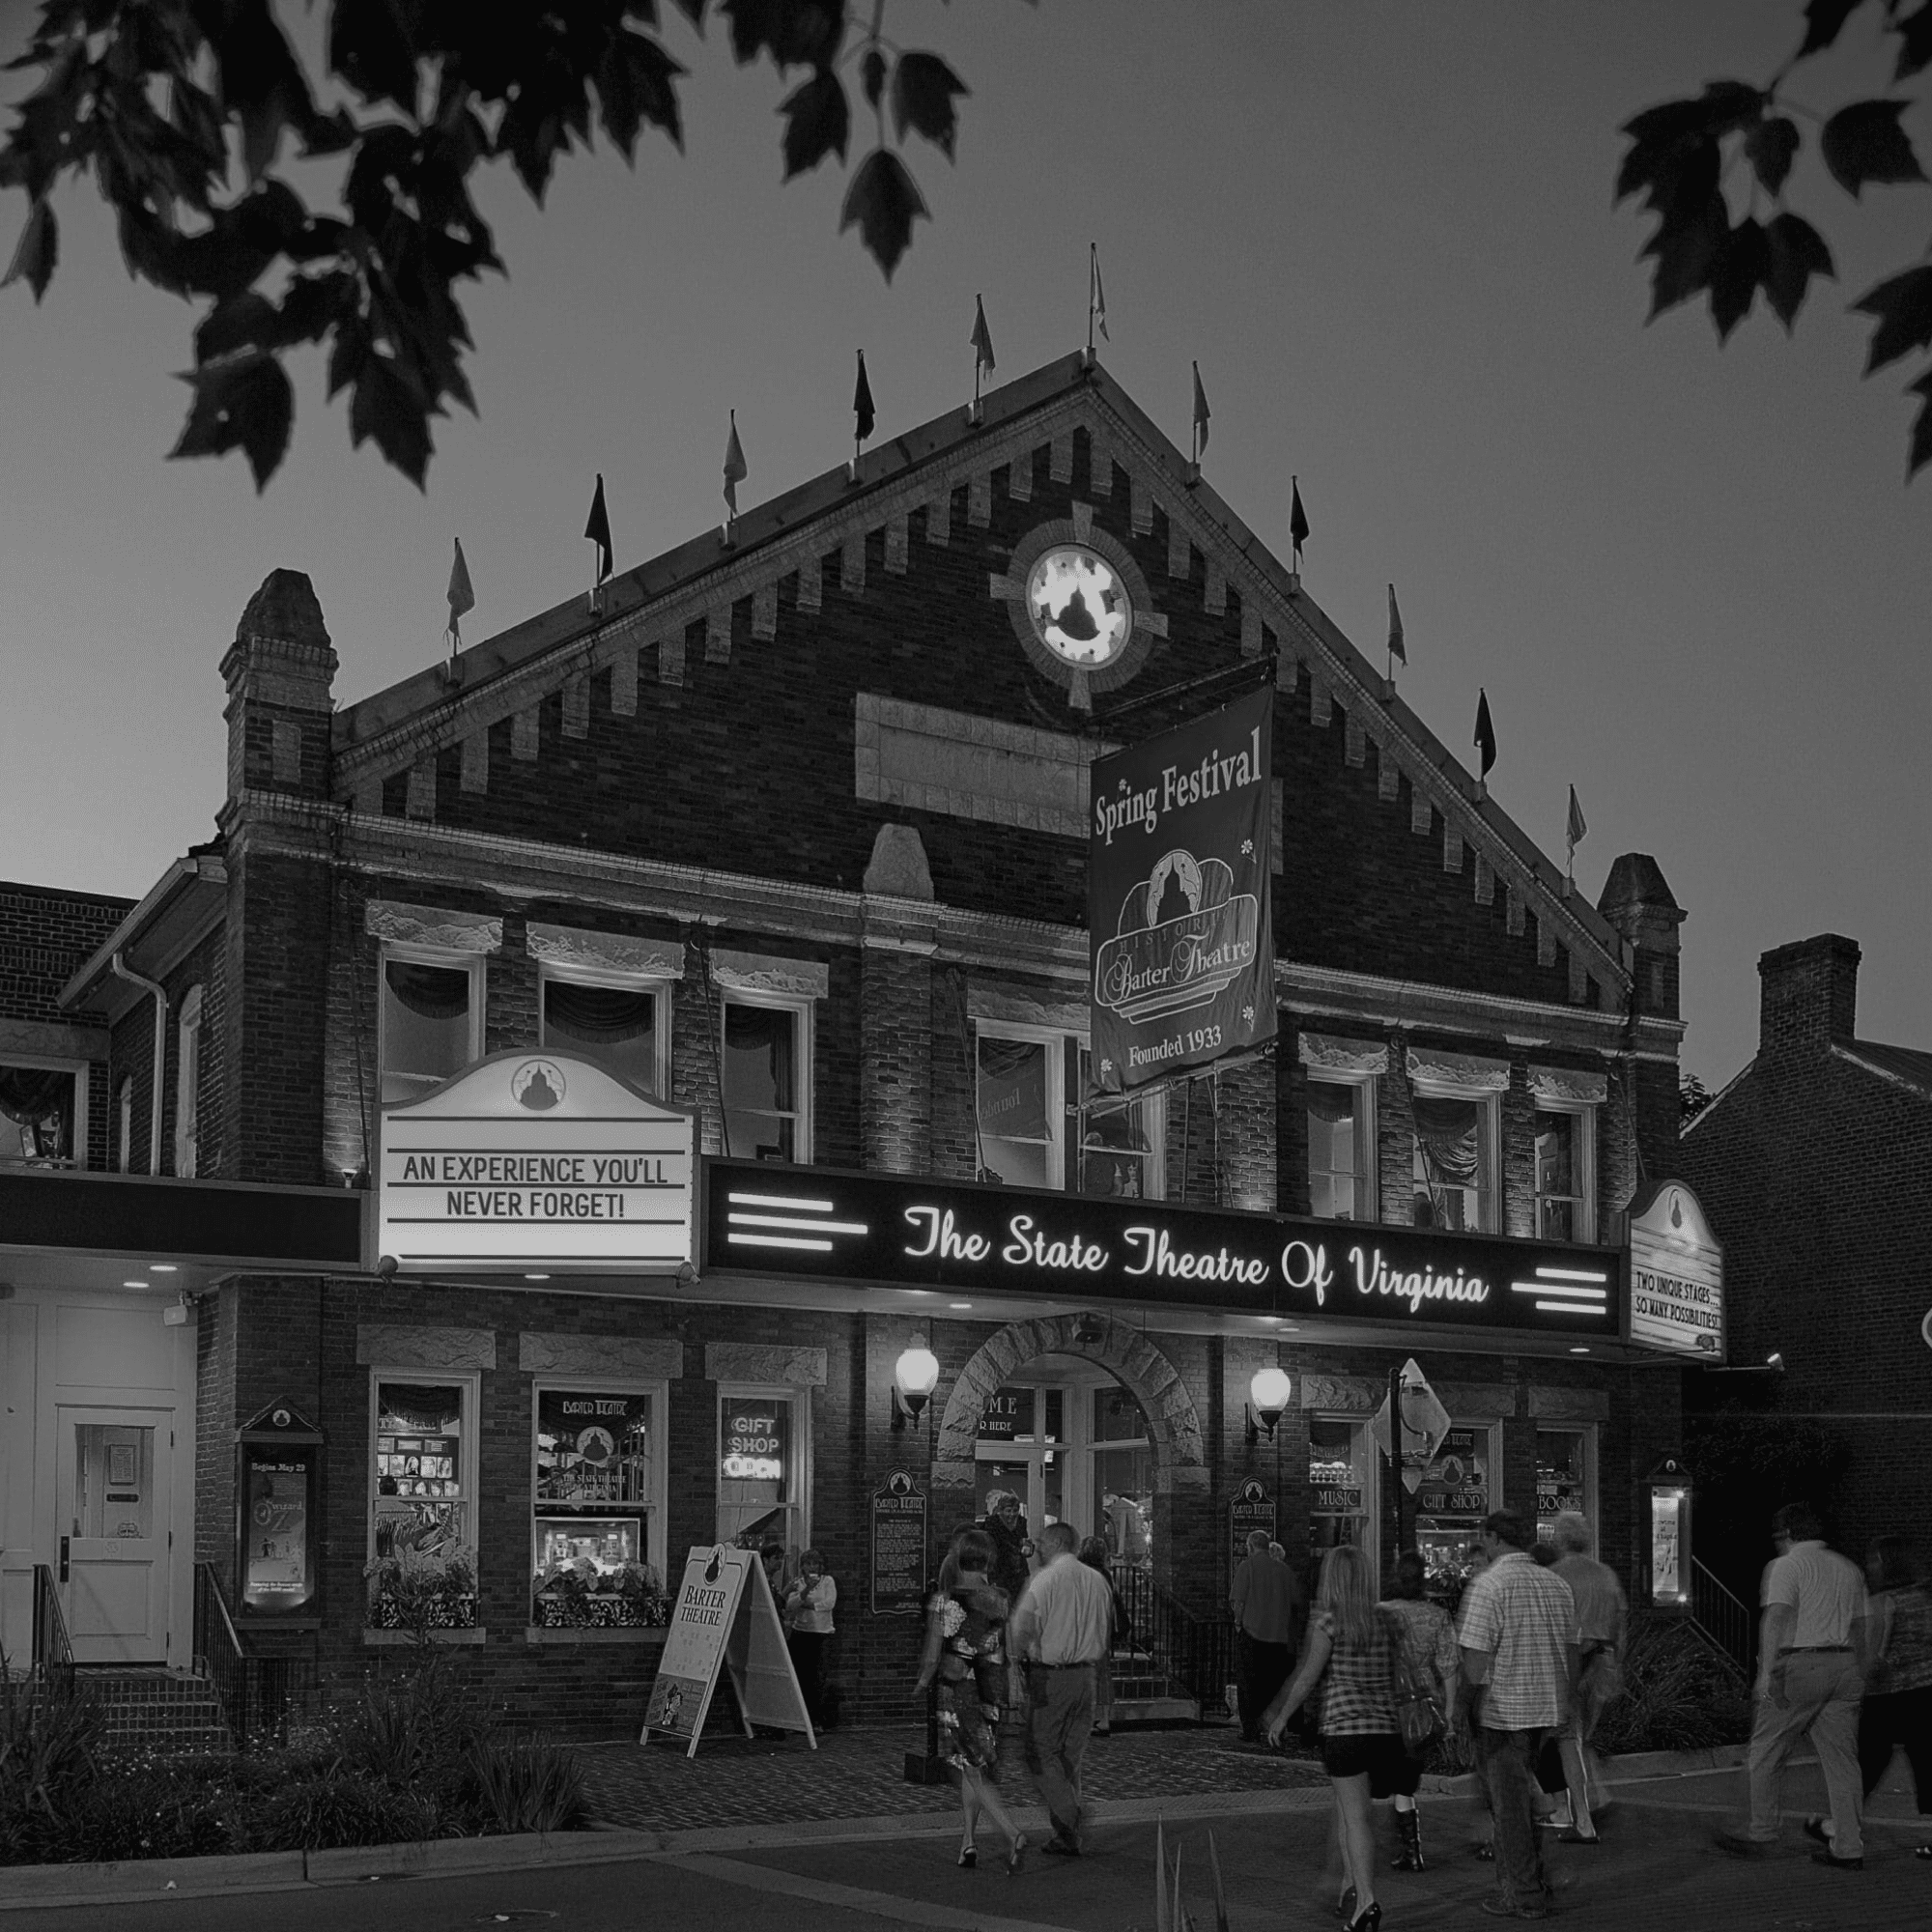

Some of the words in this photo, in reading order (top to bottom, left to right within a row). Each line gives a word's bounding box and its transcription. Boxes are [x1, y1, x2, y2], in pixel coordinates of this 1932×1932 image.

[1095, 783, 1158, 845] Spring
[1161, 725, 1262, 813] Festival
[1120, 909, 1227, 952] HISTORI
[1104, 953, 1171, 1002] Barter
[1171, 934, 1251, 983] Theatre
[1129, 1035, 1184, 1067] Founded
[1186, 1025, 1222, 1054] 1933
[403, 1156, 435, 1180] AN
[442, 1156, 585, 1182] EXPERIENCE
[593, 1157, 668, 1184] YOU'LL
[446, 1191, 523, 1216] NEVER
[529, 1192, 624, 1218] FORGET!
[904, 1206, 991, 1261] The
[1002, 1214, 1109, 1272] State
[1122, 1226, 1269, 1284] Theatre
[1281, 1240, 1333, 1306] Of
[1349, 1246, 1490, 1314] Virginia
[1636, 1270, 1655, 1292] TWO
[1657, 1275, 1683, 1299] UNIQUE
[1635, 1295, 1648, 1315] SO
[1649, 1298, 1668, 1320] MANY
[1670, 1303, 1718, 1329] POSSIBILITIES!
[562, 1401, 594, 1414] BARTER
[595, 1400, 628, 1416] THEATRE
[732, 1417, 775, 1435] GIFT
[989, 1421, 1012, 1432] HERE
[729, 1436, 779, 1453] SHOP
[277, 1463, 295, 1473] May
[577, 1474, 596, 1483] STATE
[1319, 1491, 1358, 1506] MUSIC
[1423, 1493, 1447, 1508] GIFT
[1451, 1494, 1481, 1509] SHOP
[1539, 1495, 1581, 1510] BOOKS
[684, 1585, 725, 1609] BARTER
[680, 1606, 722, 1627] THEATRE
